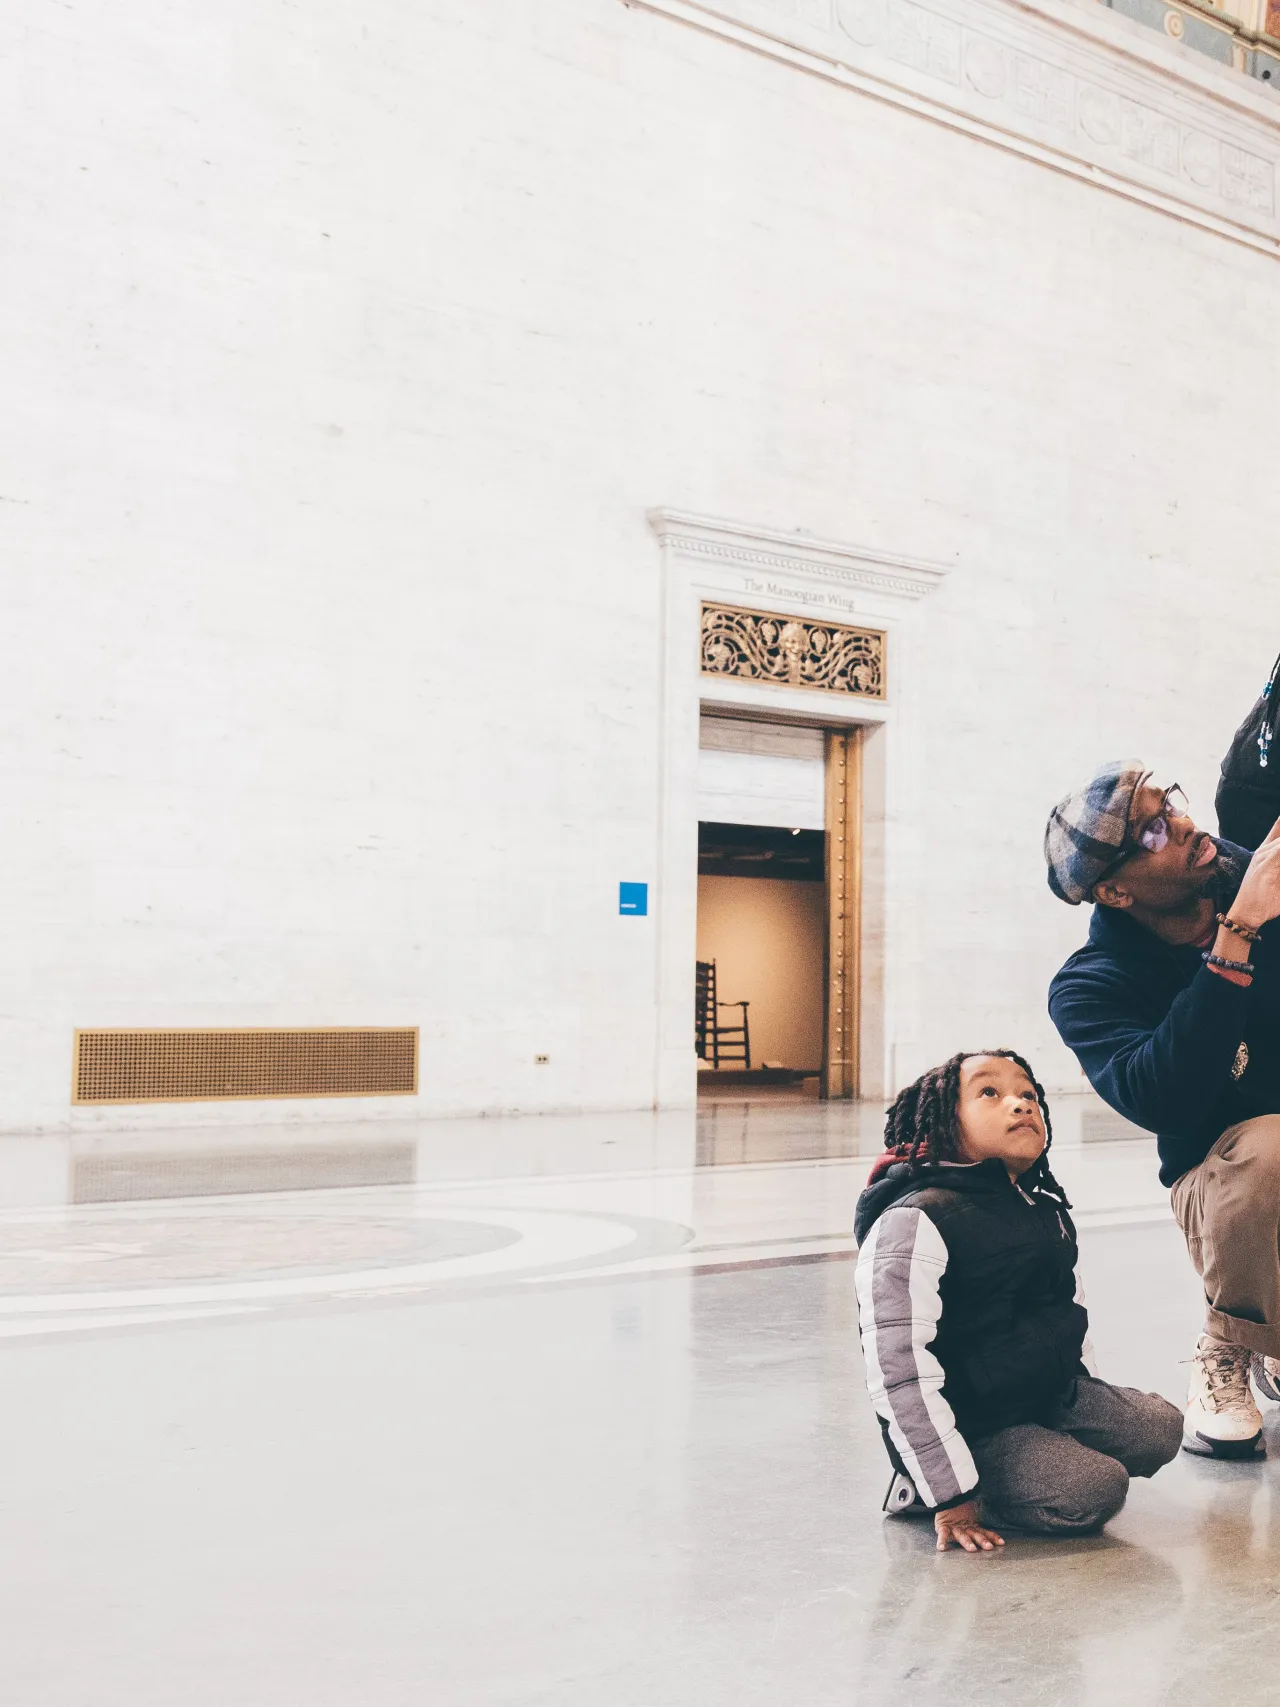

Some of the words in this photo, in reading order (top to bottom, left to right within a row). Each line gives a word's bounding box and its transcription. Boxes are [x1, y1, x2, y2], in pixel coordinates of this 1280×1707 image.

[743, 578, 764, 592] The
[767, 583, 825, 605] Manoogian
[828, 594, 855, 612] Wing
